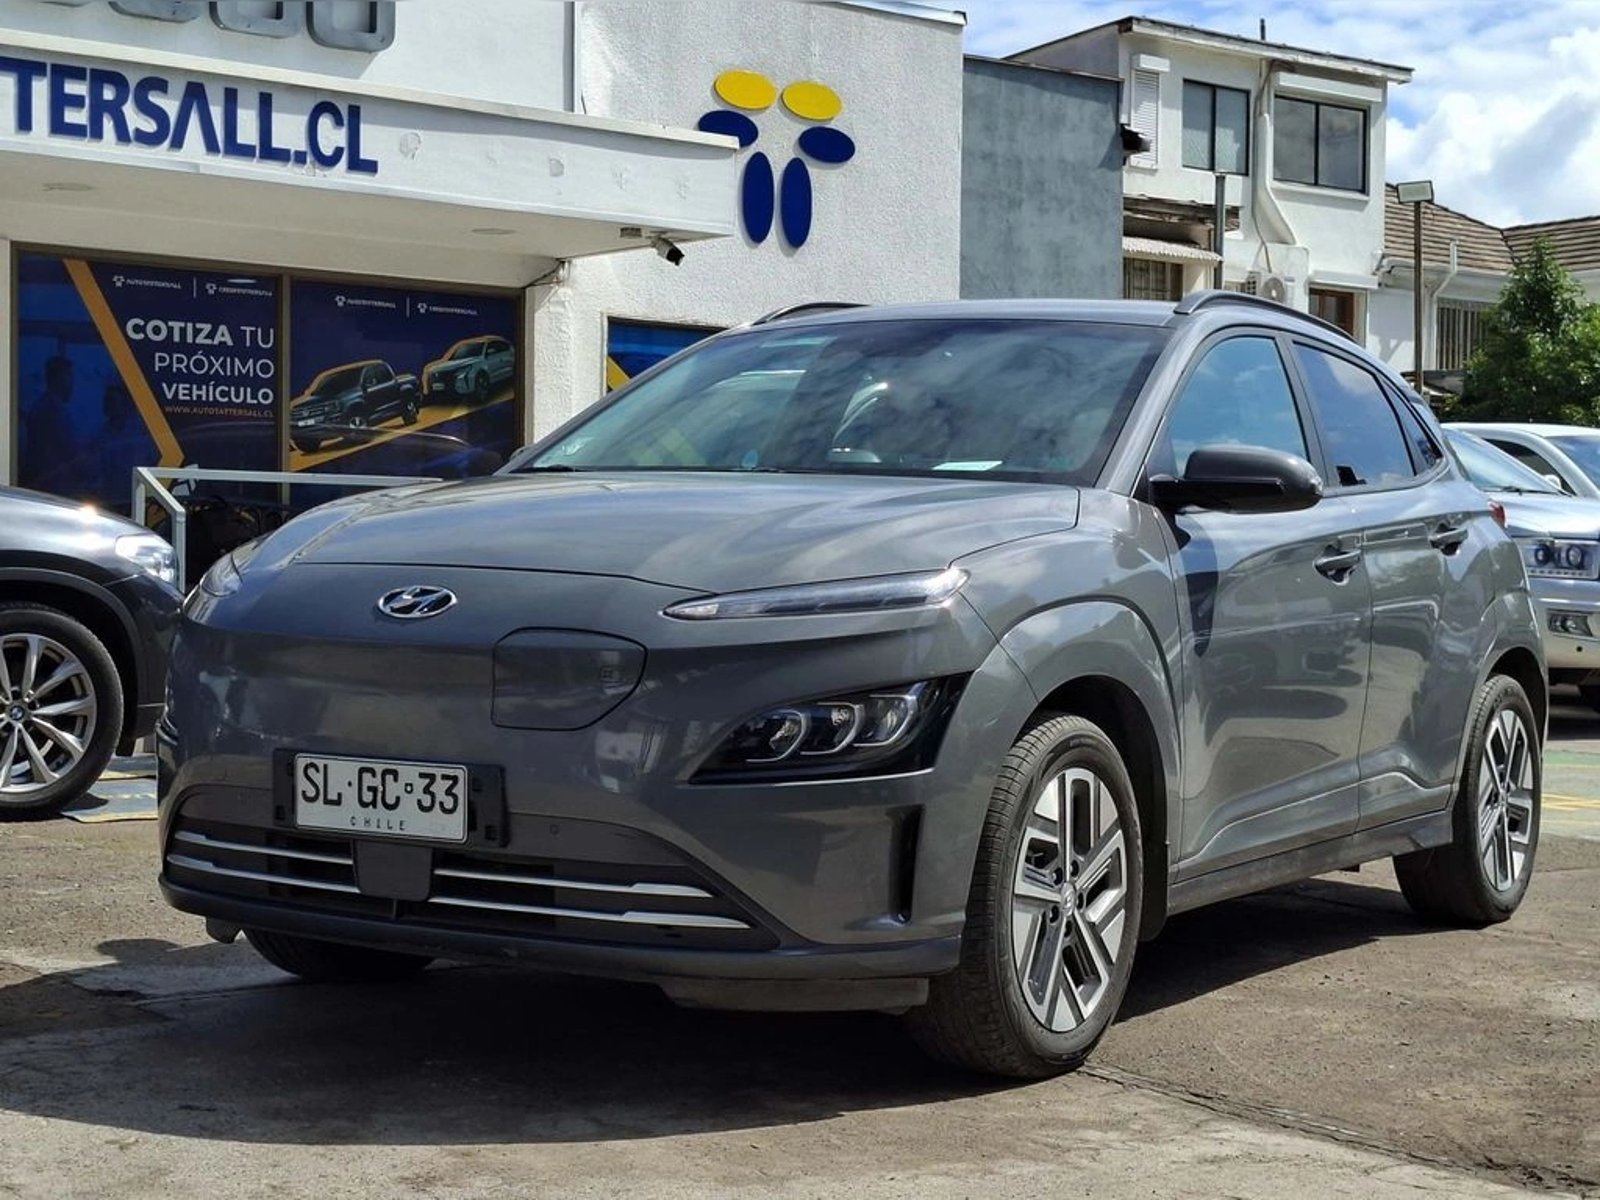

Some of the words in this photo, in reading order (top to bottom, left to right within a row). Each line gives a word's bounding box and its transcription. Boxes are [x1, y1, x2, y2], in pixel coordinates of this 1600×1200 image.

[125, 317, 234, 347] COTIZA
[240, 325, 275, 349] TU
[154, 350, 275, 379] PRÓXIMO
[162, 380, 274, 405] VEHÍCULO
[350, 815, 406, 831] CHILE
